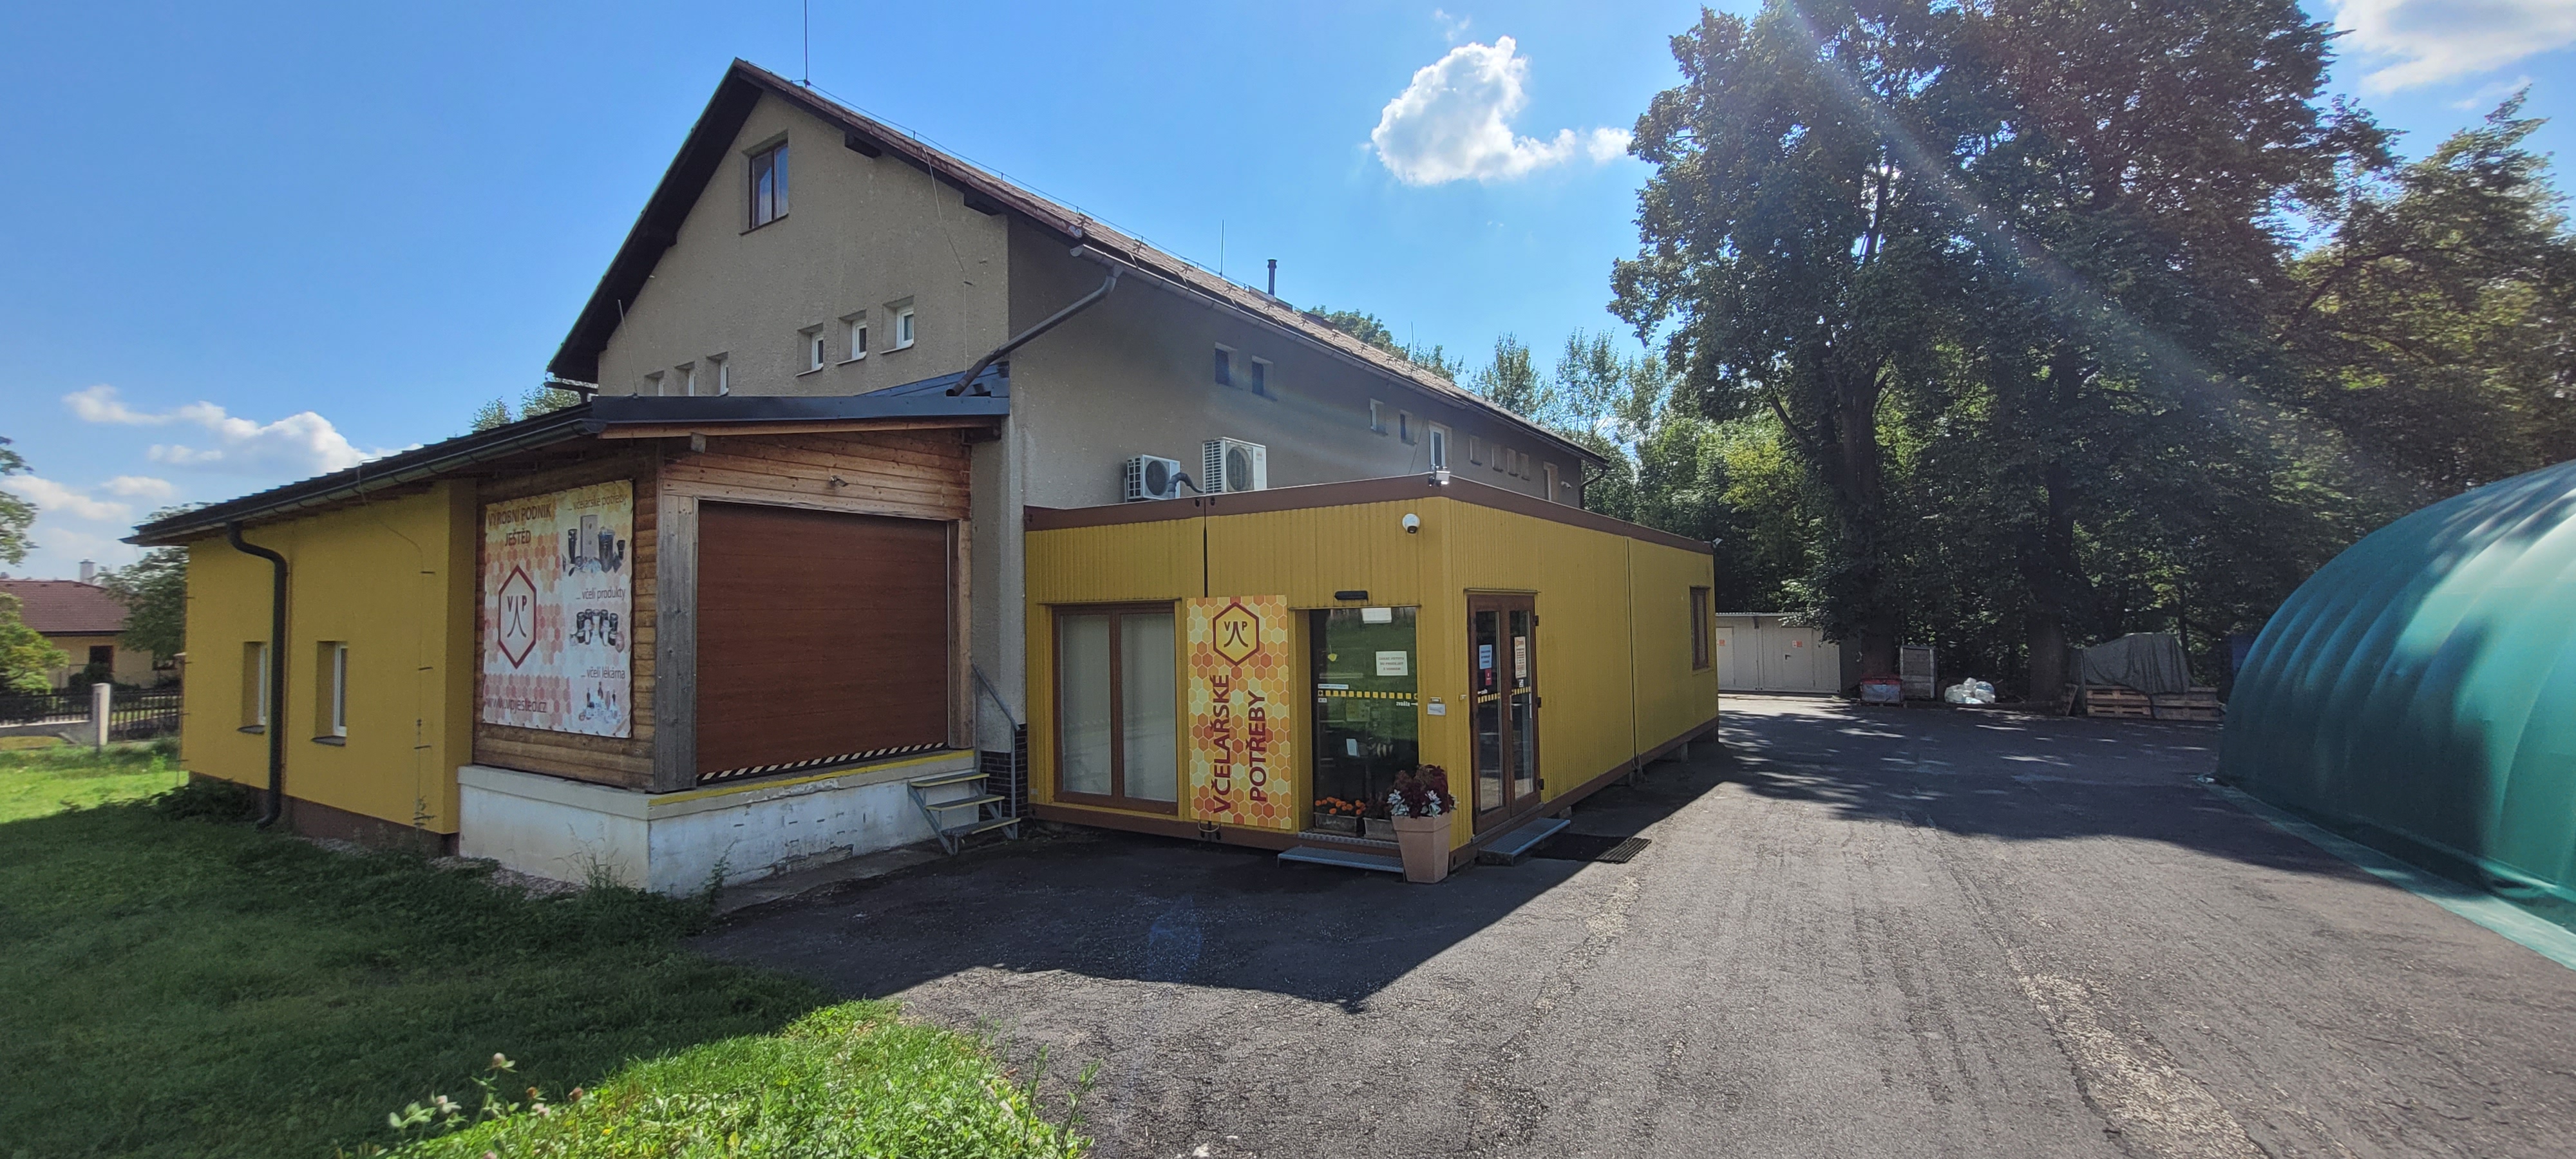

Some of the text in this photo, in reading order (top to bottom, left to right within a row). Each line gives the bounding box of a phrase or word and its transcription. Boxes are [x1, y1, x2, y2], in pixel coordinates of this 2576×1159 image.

[488, 504, 552, 526] VÝROBNÍ PODNIK
[505, 528, 531, 547] JEŠTĚD
[582, 587, 595, 599] včelí
[597, 587, 626, 600] produkty
[587, 666, 600, 678] včelí
[602, 666, 625, 679] lékárna
[1209, 674, 1231, 813] VČELAŘSKÉ
[1245, 690, 1267, 802] POTŘEBY
